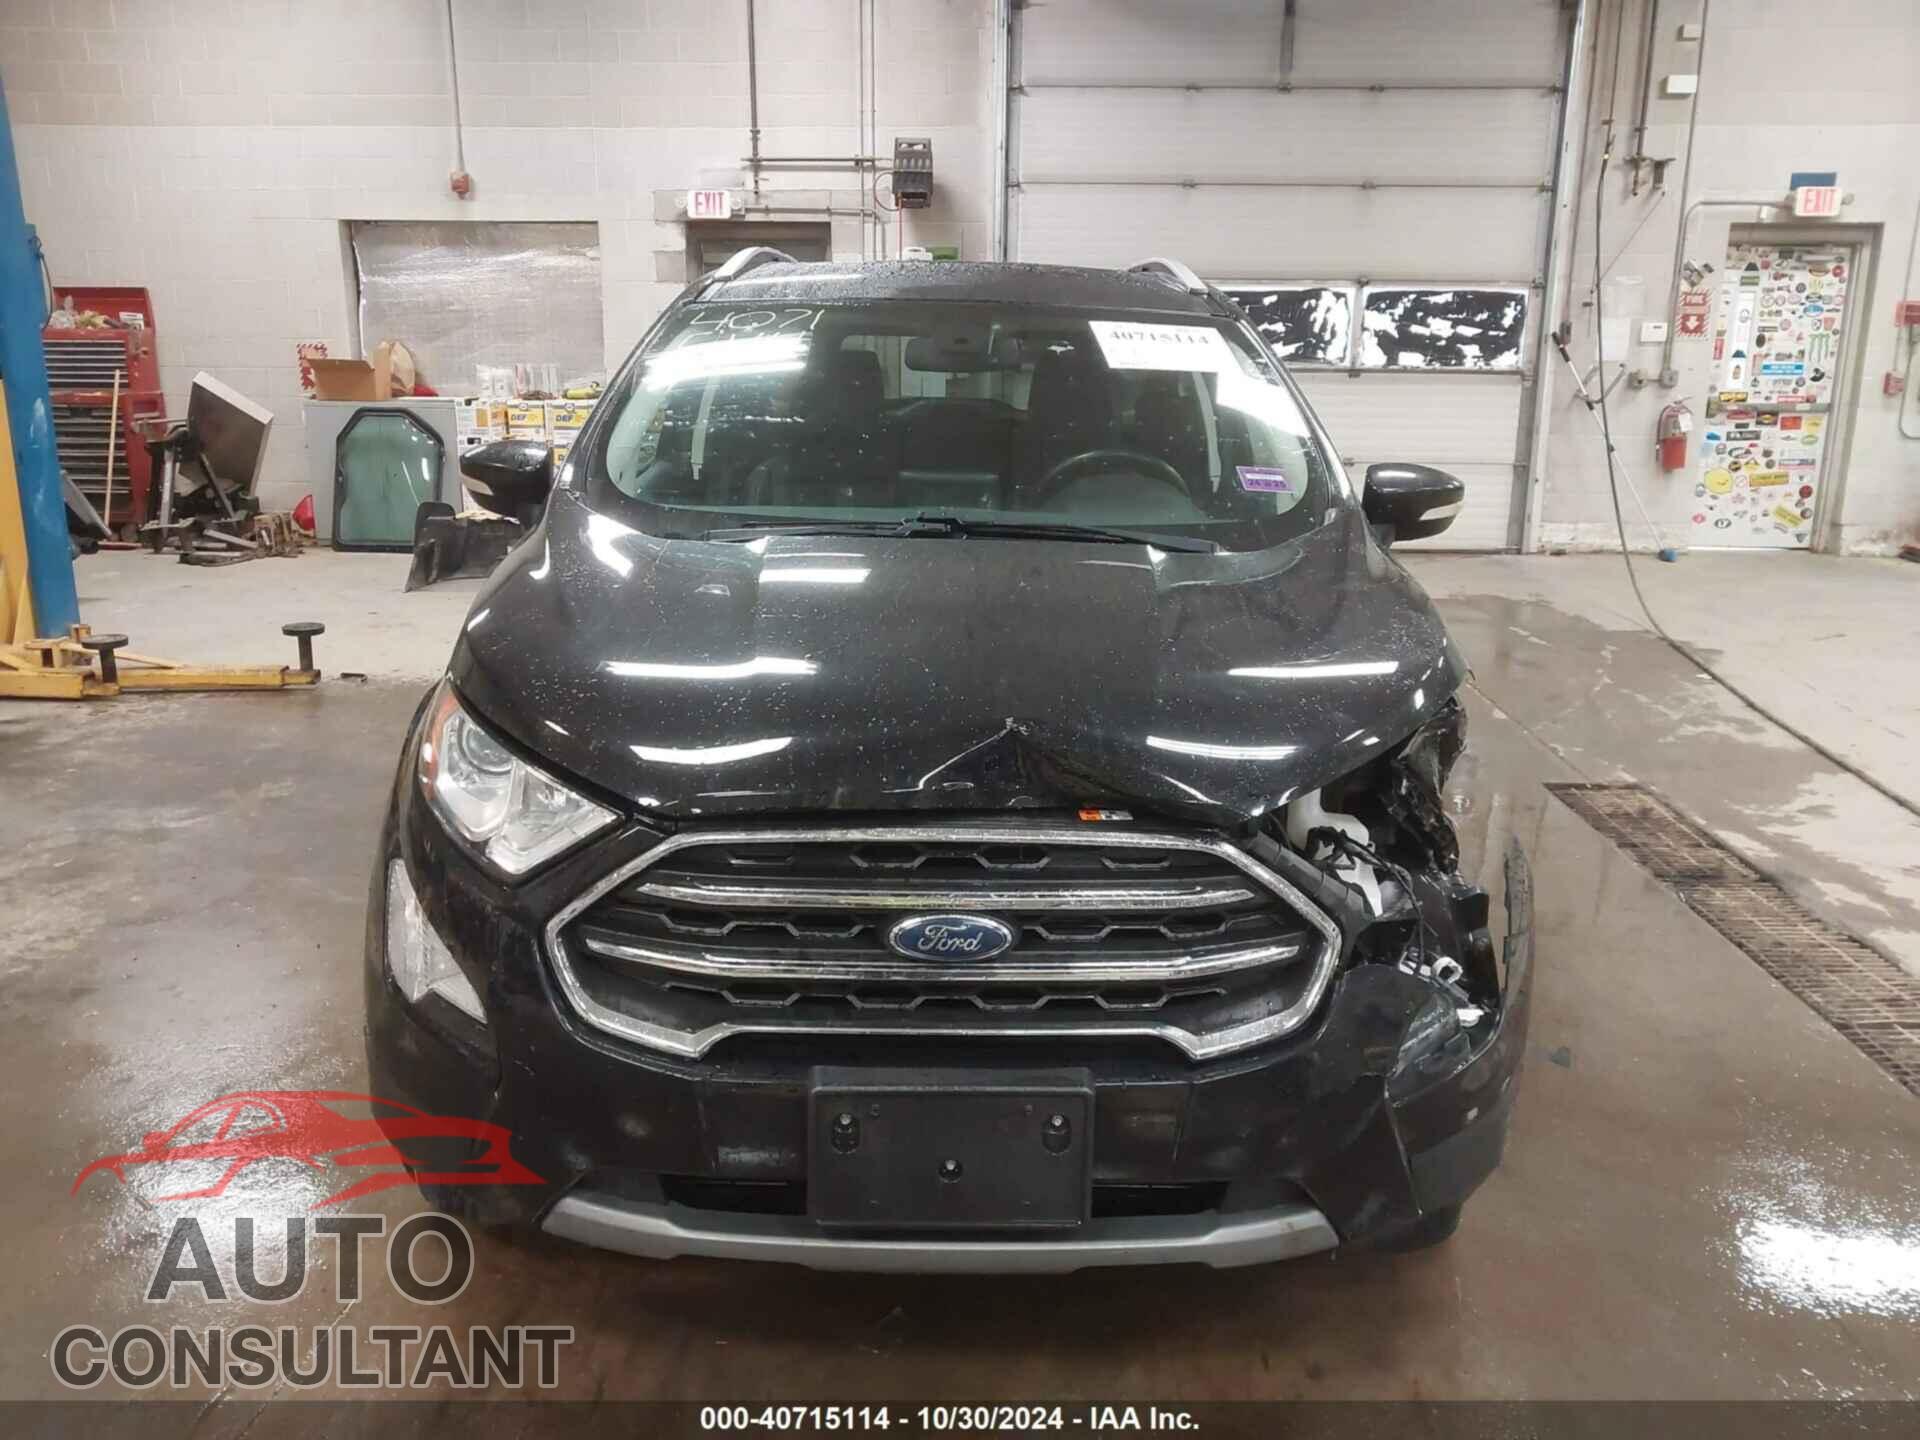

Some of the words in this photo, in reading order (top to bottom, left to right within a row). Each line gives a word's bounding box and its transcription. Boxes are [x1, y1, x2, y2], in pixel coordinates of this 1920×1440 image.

[695, 191, 724, 216] EXIT
[1803, 188, 1836, 213] EXIT
[510, 413, 528, 421] DEF
[555, 414, 573, 422] DEF
[917, 925, 984, 951] Ford
